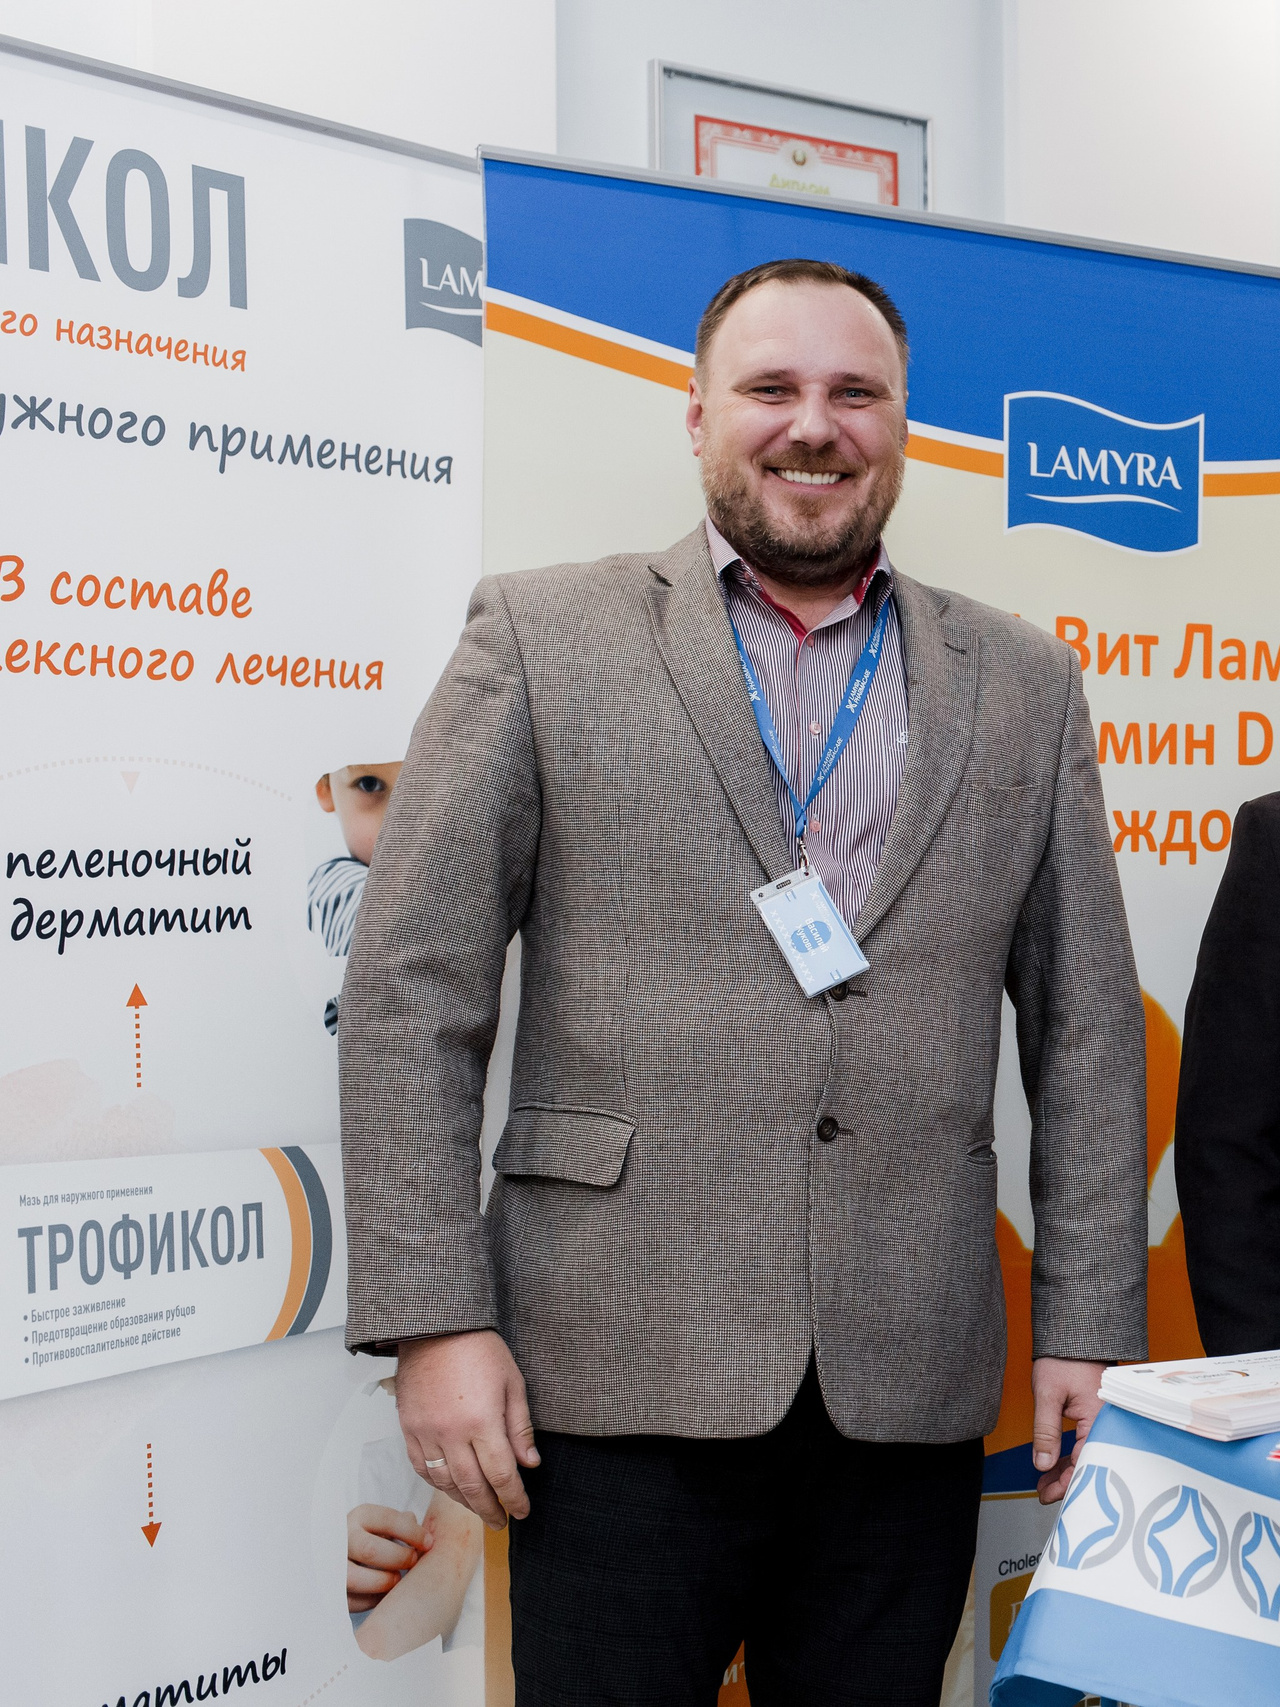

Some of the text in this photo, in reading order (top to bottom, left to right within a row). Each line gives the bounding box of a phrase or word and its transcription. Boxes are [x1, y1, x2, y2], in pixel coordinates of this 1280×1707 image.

[0, 119, 248, 311] КОЛ
[55, 317, 248, 372] назначения
[188, 421, 454, 486] применения
[1027, 442, 1183, 490] LAMYRA
[50, 568, 253, 619] составе
[0, 638, 385, 691] ексного лечения
[1055, 615, 1160, 677] Вит
[854, 668, 872, 704] PHARMACARE
[1098, 710, 1274, 766] мин D
[6, 837, 252, 879] пеленочный
[1112, 809, 1232, 866] ждо
[10, 897, 253, 956] дерматит
[19, 1185, 154, 1207] Мазь для наружного применения
[17, 1201, 265, 1294] ТРОФИКОЛ
[31, 1297, 126, 1323] Быстрое заживление
[31, 1304, 196, 1345] Предотвращение образования рубцов
[32, 1325, 182, 1367] Противовоспалительное действие
